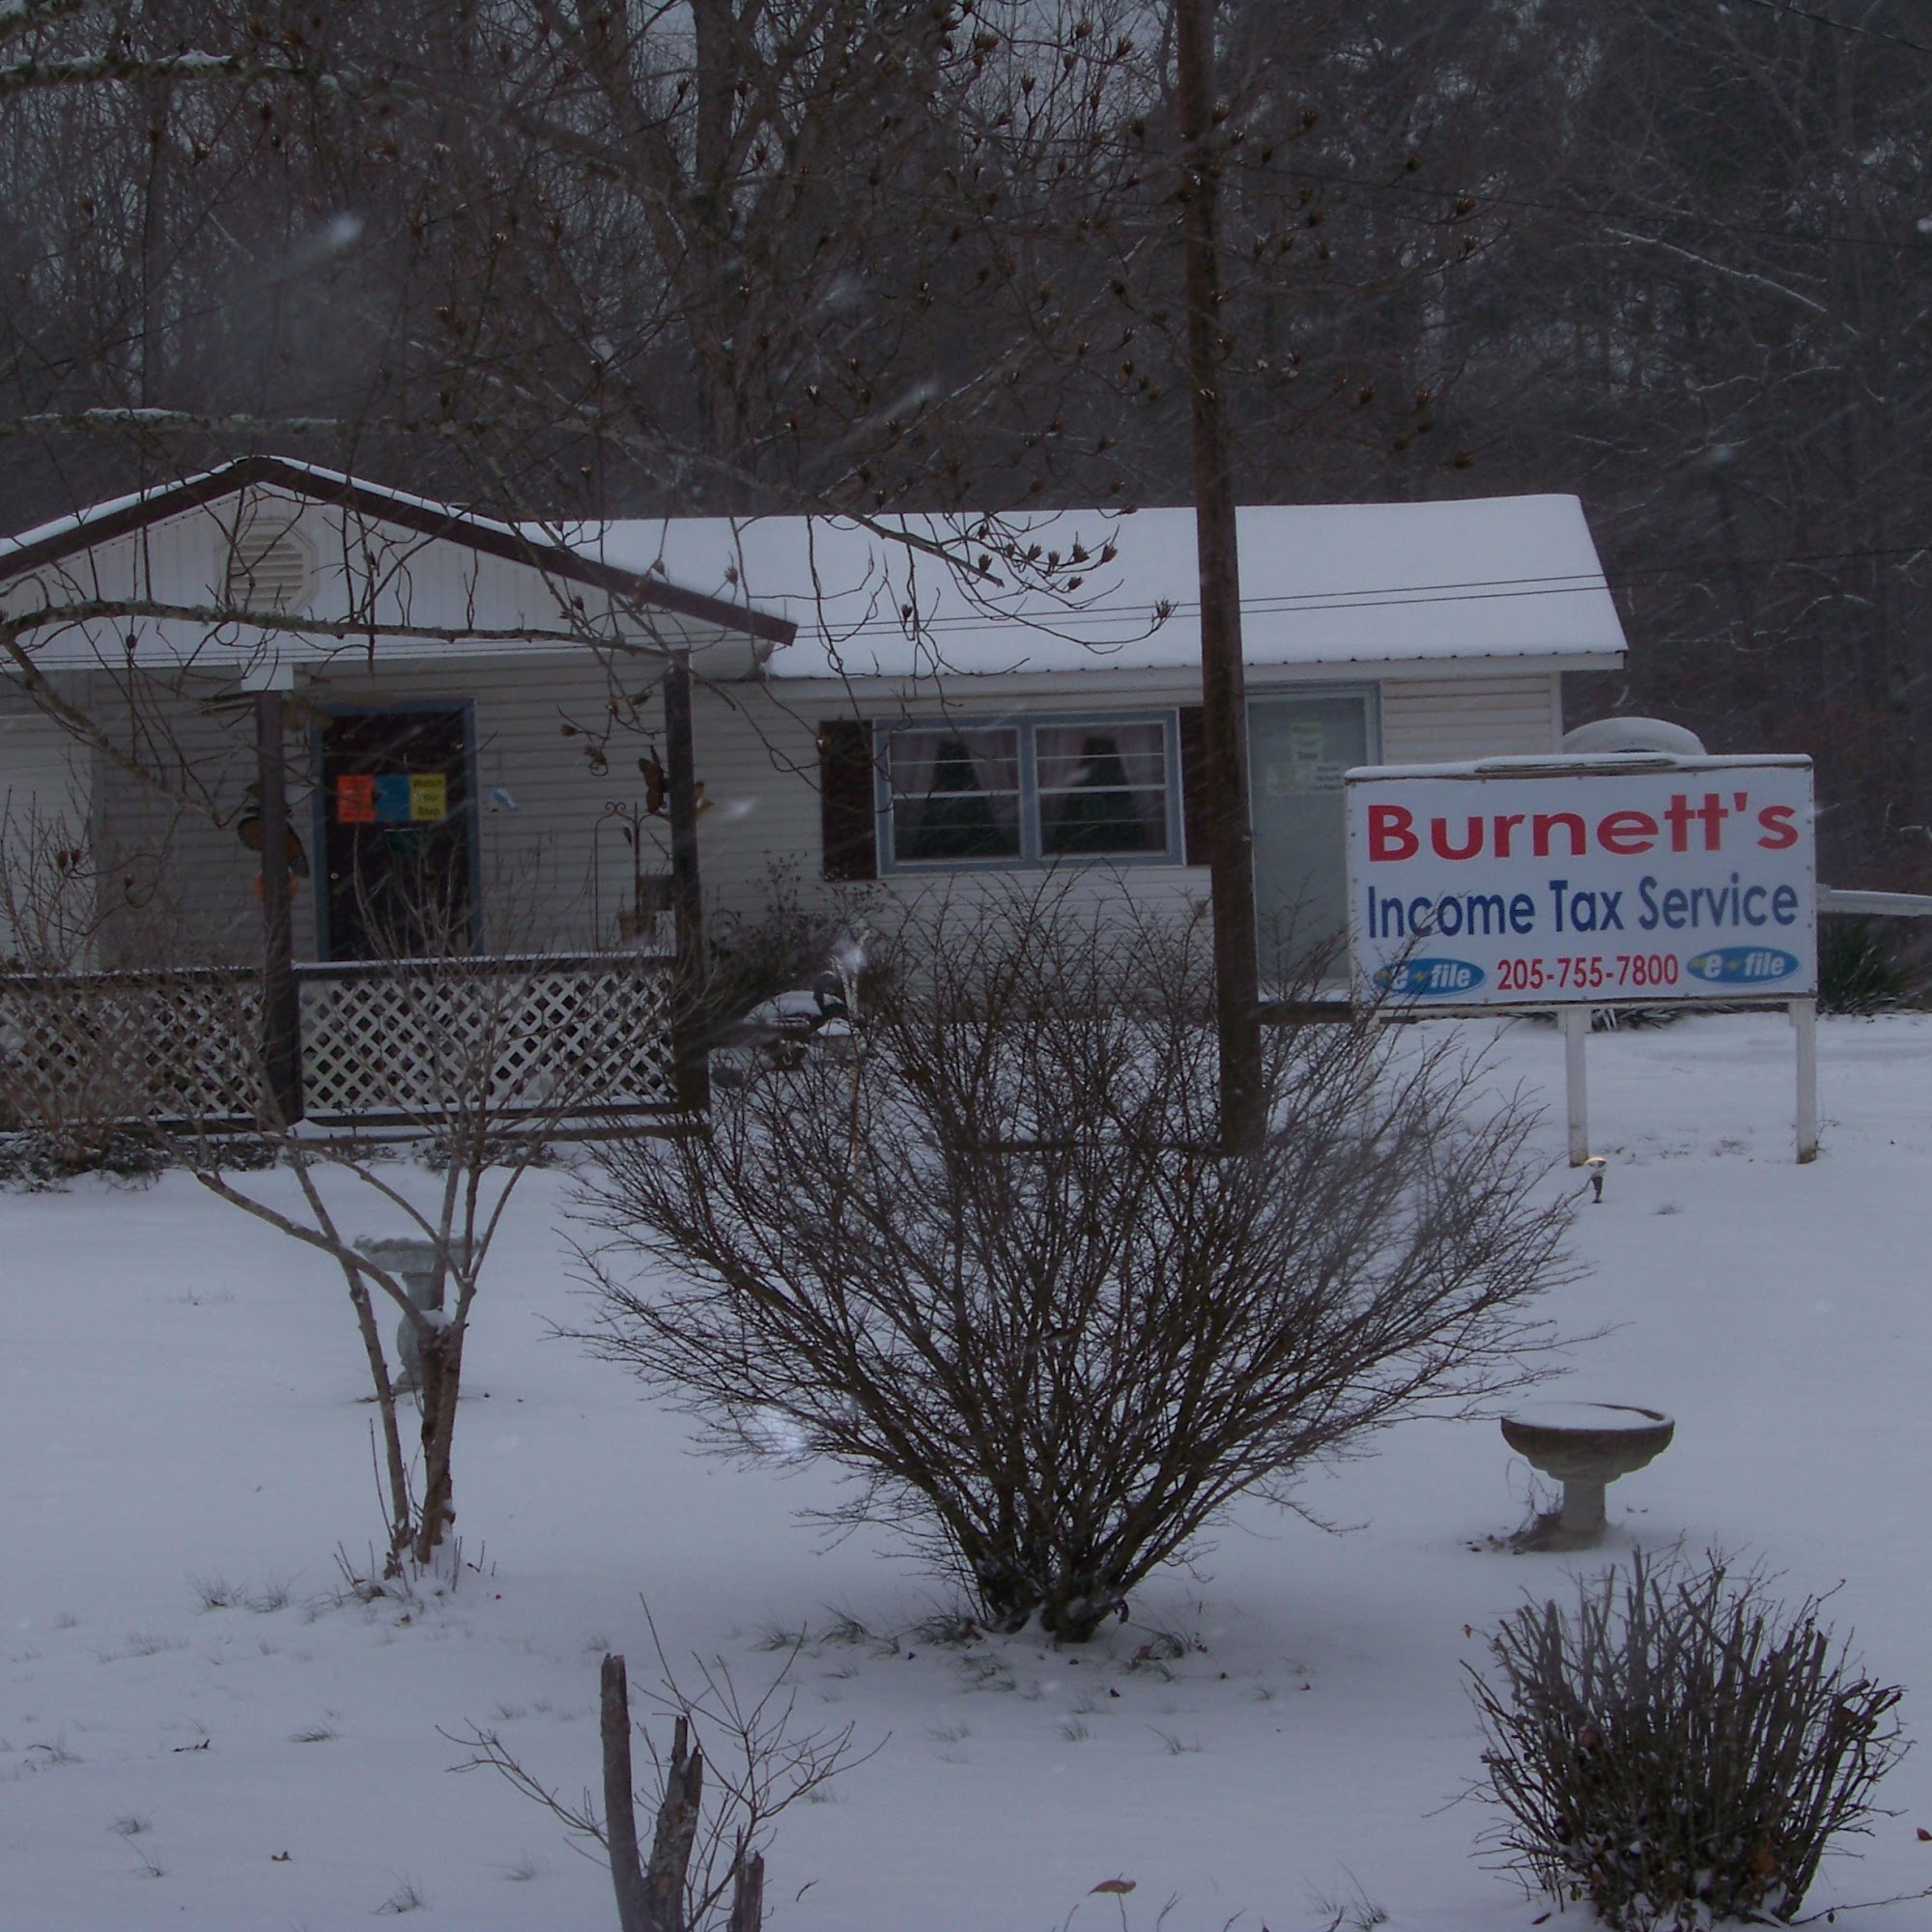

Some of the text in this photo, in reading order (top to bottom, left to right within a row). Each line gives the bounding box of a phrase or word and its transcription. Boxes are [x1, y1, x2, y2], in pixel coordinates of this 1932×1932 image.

[1368, 792, 1799, 862] Burnett's
[1368, 872, 1799, 939] Income Tax Service
[1497, 954, 1679, 991] 205-755-7800
